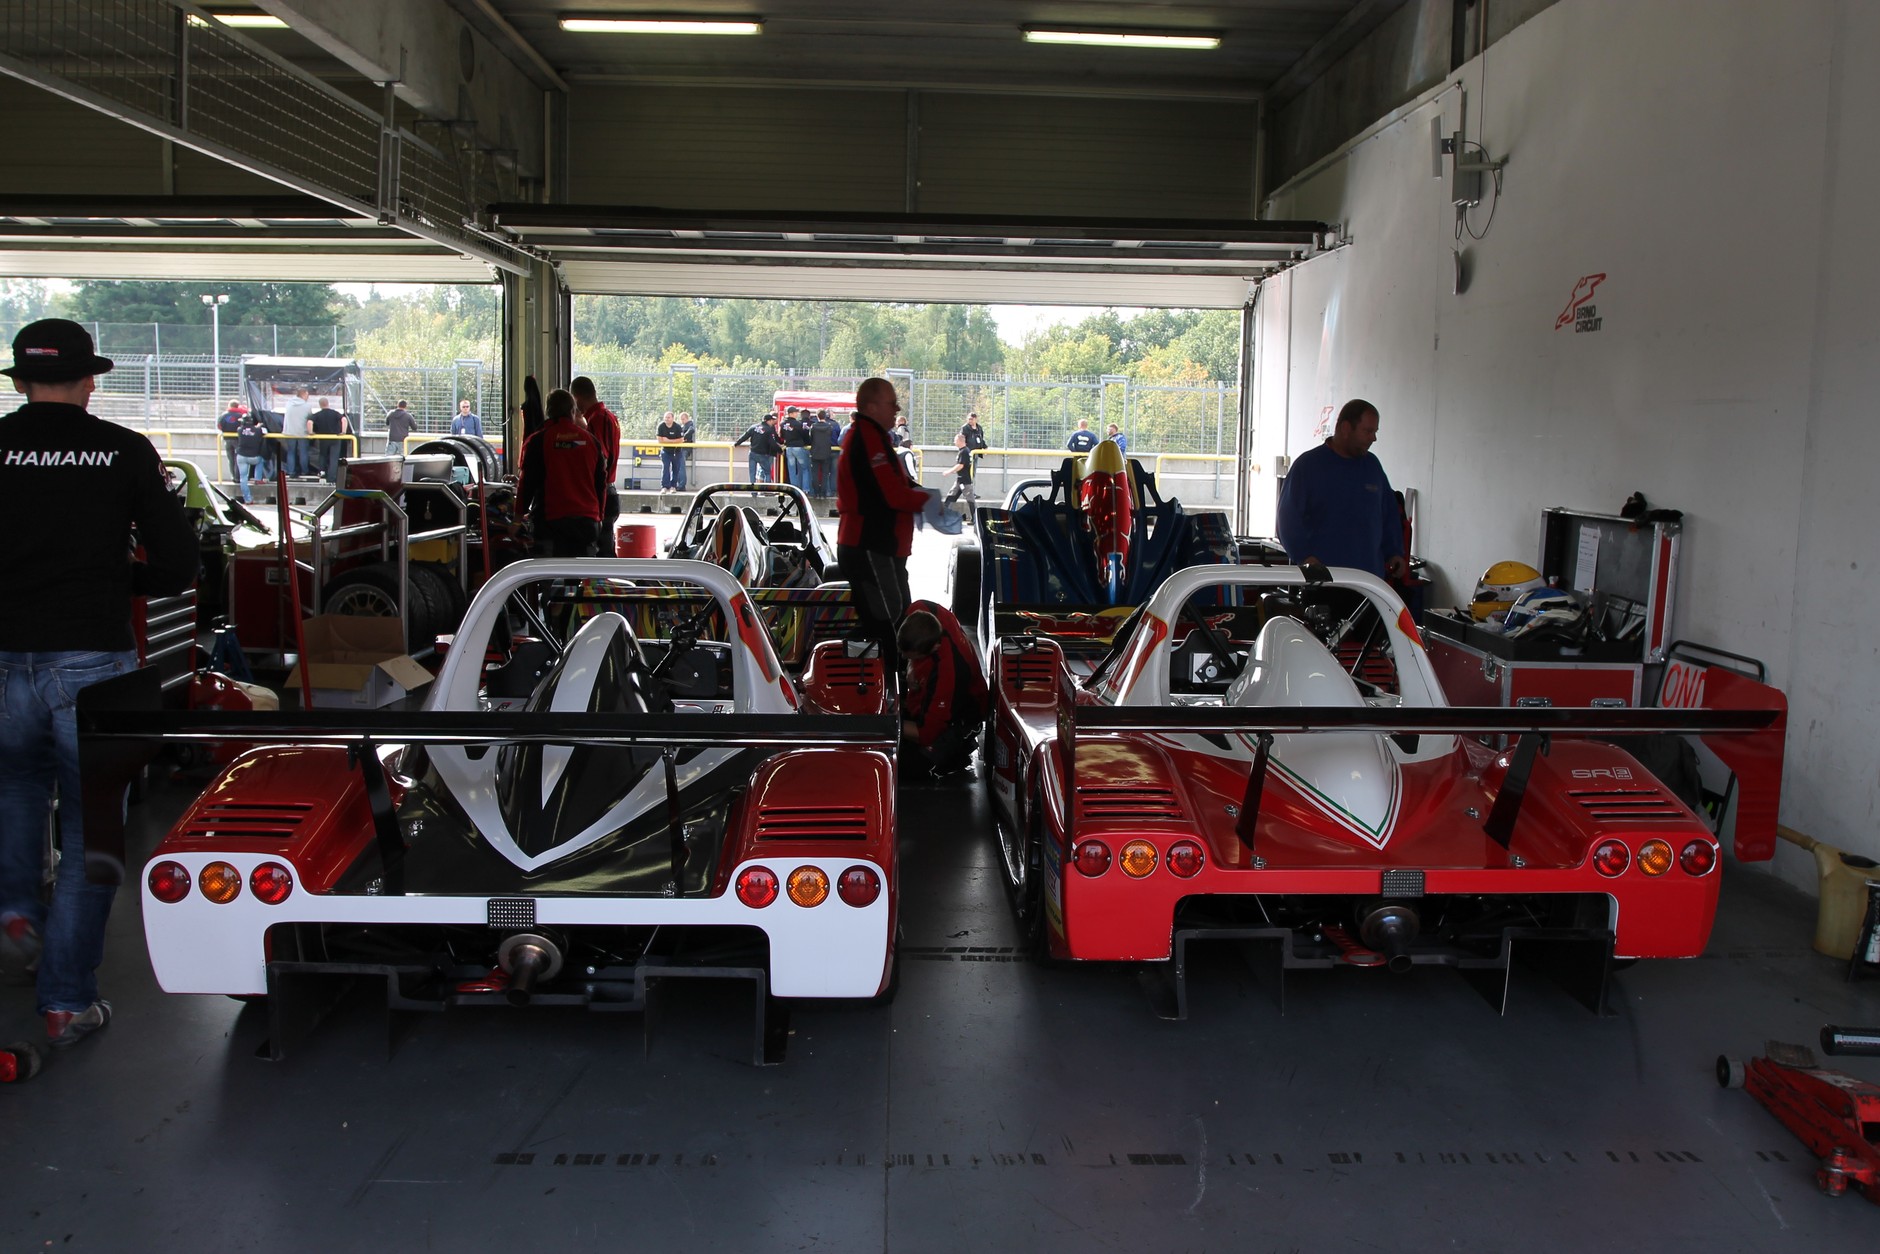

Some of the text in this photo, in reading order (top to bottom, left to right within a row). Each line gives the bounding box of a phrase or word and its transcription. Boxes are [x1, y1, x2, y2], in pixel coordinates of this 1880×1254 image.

[1576, 305, 1596, 319] BRNO
[1575, 317, 1602, 333] CIRCUIT
[4, 450, 114, 466] HAMANN
